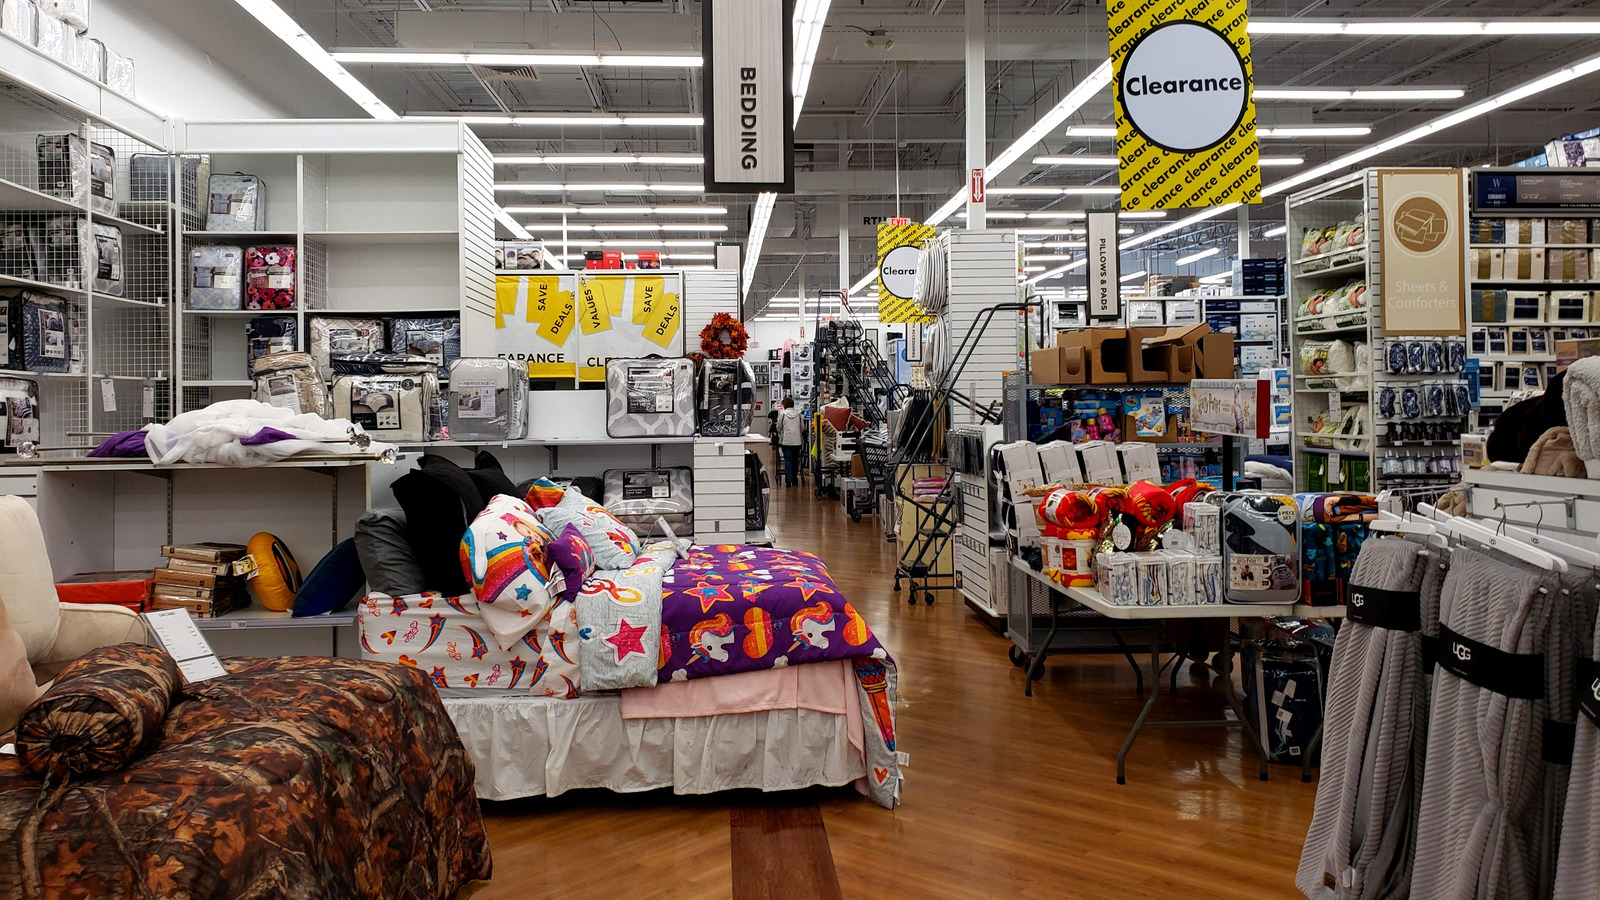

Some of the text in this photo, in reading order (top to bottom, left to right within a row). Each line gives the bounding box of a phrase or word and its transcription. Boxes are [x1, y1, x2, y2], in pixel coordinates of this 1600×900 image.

[1109, 0, 1160, 41] clearanc
[1111, 27, 1147, 63] arance
[1126, 75, 1242, 96] Clearance
[741, 67, 757, 170] BEDDING
[1121, 157, 1161, 191] arance
[1142, 152, 1196, 197] clearance
[1150, 184, 1183, 210] rance
[1184, 137, 1237, 184] clearance
[1179, 177, 1218, 208] arance
[1219, 140, 1259, 177] clearan
[1207, 165, 1258, 206] learance
[883, 266, 917, 276] Cleara
[1099, 238, 1107, 277] PILLOWS
[538, 284, 548, 311] SAVE
[644, 286, 654, 313] SAVE
[1100, 288, 1108, 311] PADS
[1387, 296, 1456, 309] Comforters
[1395, 280, 1449, 293] Sheets &
[550, 303, 573, 335] DEALS
[585, 288, 601, 329] VALUES
[656, 305, 678, 336] DEALS
[1352, 593, 1364, 607] UGG
[1453, 642, 1471, 661] UGG
